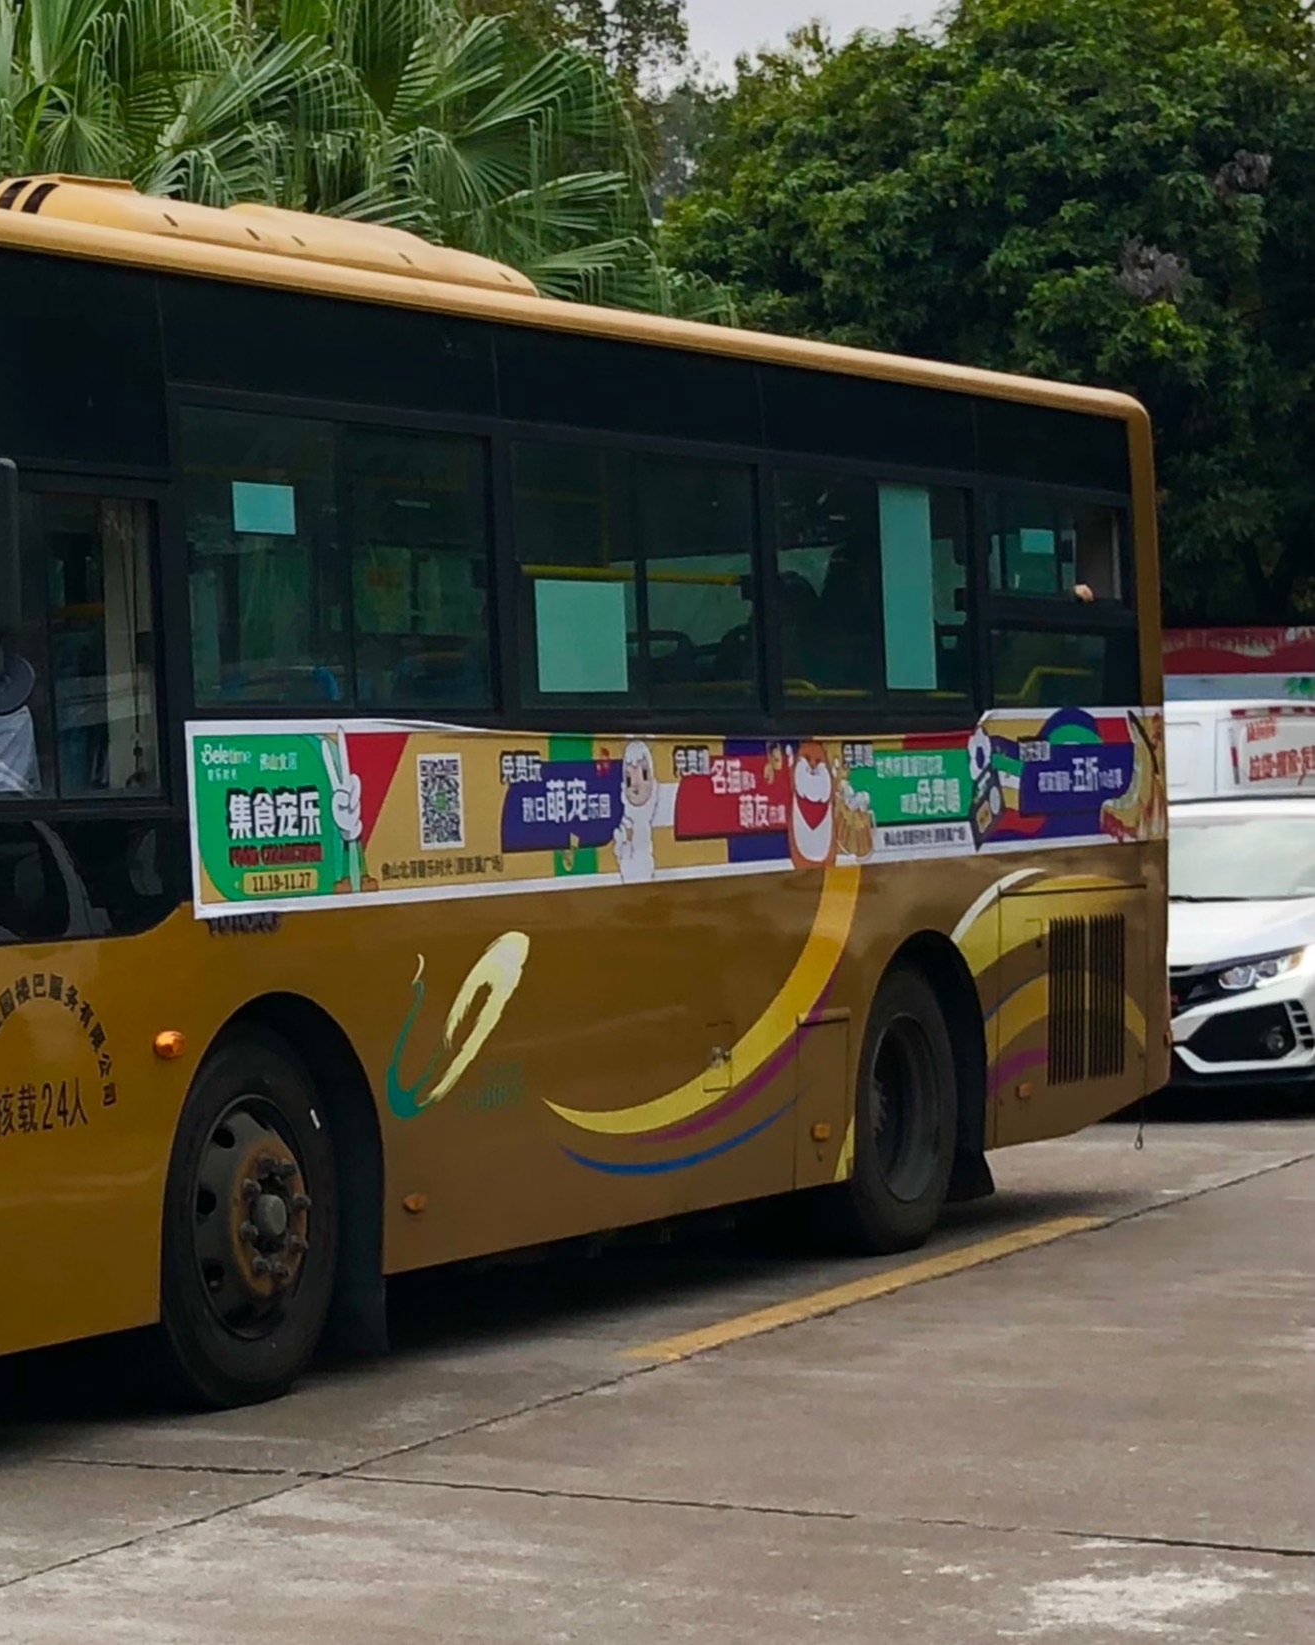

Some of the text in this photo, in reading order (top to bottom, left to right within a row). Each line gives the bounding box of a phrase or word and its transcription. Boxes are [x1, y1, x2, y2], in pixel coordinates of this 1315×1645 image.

[500, 751, 543, 784] 免费玩
[227, 789, 323, 840] 集食宠乐
[251, 871, 313, 893] 11.19-11.27
